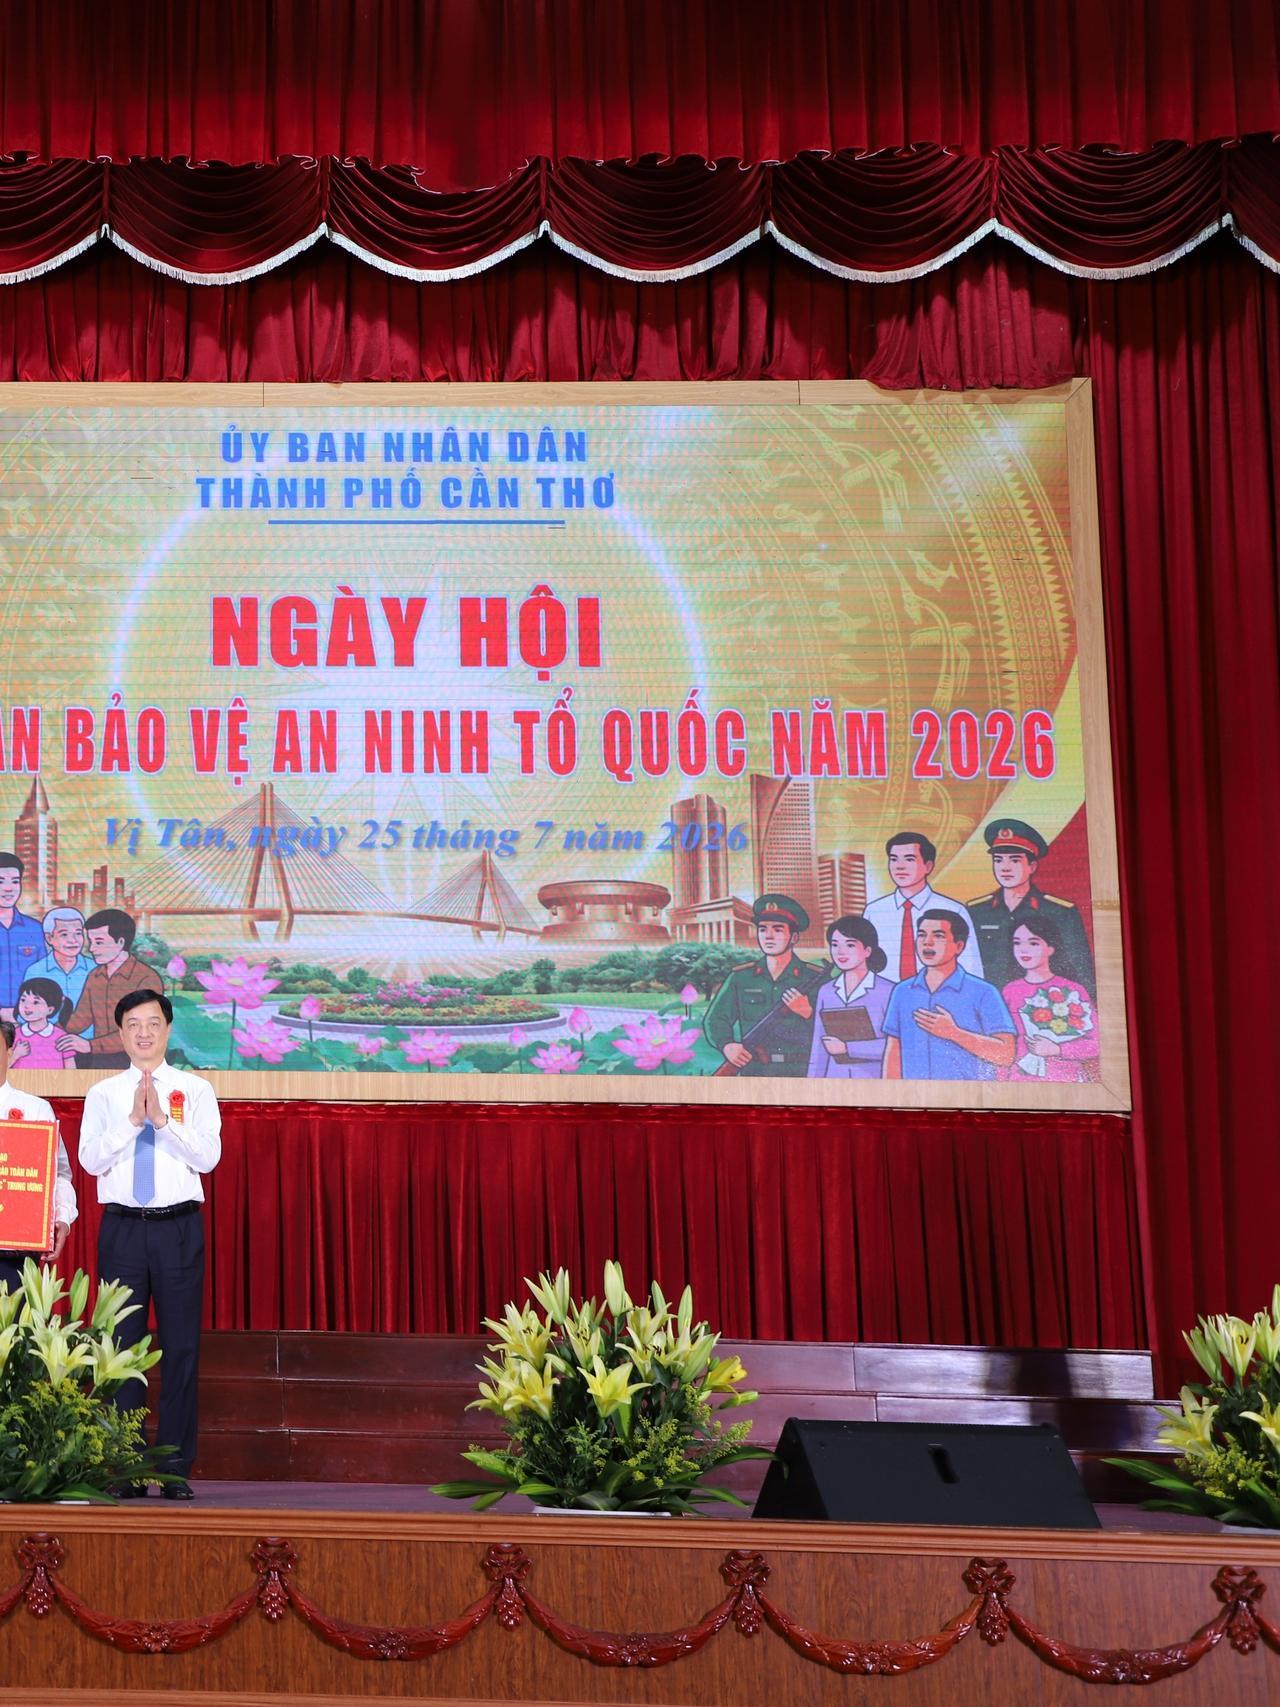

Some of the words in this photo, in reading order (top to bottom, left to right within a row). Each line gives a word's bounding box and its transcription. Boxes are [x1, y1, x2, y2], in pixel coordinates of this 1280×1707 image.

[221, 424, 269, 463] ỦY
[288, 431, 365, 463] BAN
[383, 426, 489, 463] NHÂN
[508, 426, 586, 463] DÂN
[196, 472, 326, 509] THÀNH
[344, 467, 421, 509] PHỐ
[441, 467, 519, 509] CẦN
[536, 472, 615, 509] THƠ
[212, 586, 427, 667] NGÀY
[460, 584, 601, 682] HỘI
[64, 692, 166, 775] BẢO
[190, 698, 249, 786] VỆ
[273, 708, 338, 775] AN
[363, 709, 490, 775] NINH
[514, 686, 578, 776] TỔ
[602, 689, 747, 783] QUỐC
[772, 700, 888, 778] NĂM
[911, 709, 1056, 779] 2026
[103, 817, 140, 854] Vị
[157, 817, 237, 854] Tân,
[249, 817, 347, 858] ngày
[361, 818, 400, 849] 25
[413, 818, 519, 858] tháng
[535, 820, 554, 850] 7
[563, 822, 644, 850] năm
[660, 820, 748, 850] 2026
